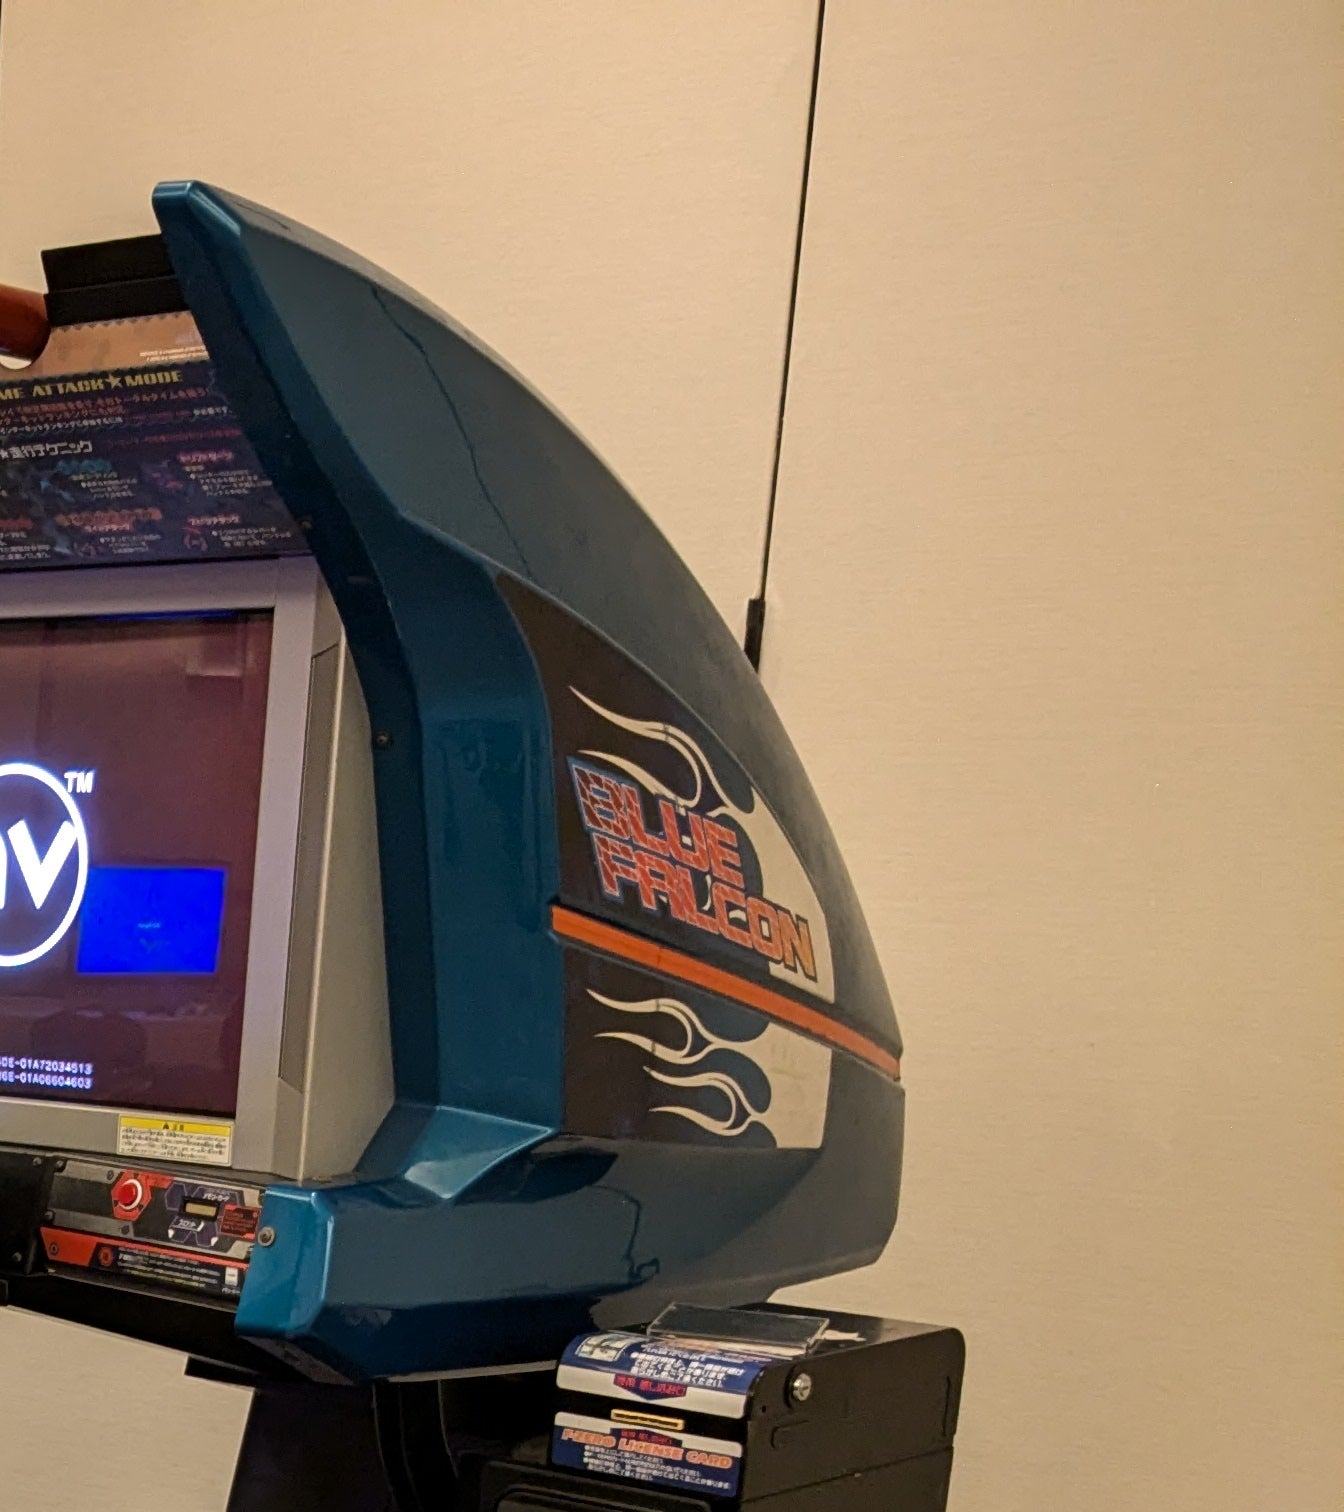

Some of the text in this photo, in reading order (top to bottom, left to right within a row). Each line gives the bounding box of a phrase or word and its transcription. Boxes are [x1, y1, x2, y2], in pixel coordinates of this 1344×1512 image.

[32, 379, 104, 398] ATTACK
[123, 370, 183, 388] MODE
[567, 755, 744, 888] BLUE
[589, 831, 820, 983] FALCON
[618, 1438, 685, 1461] LICENSE
[686, 1450, 733, 1469] CARD
